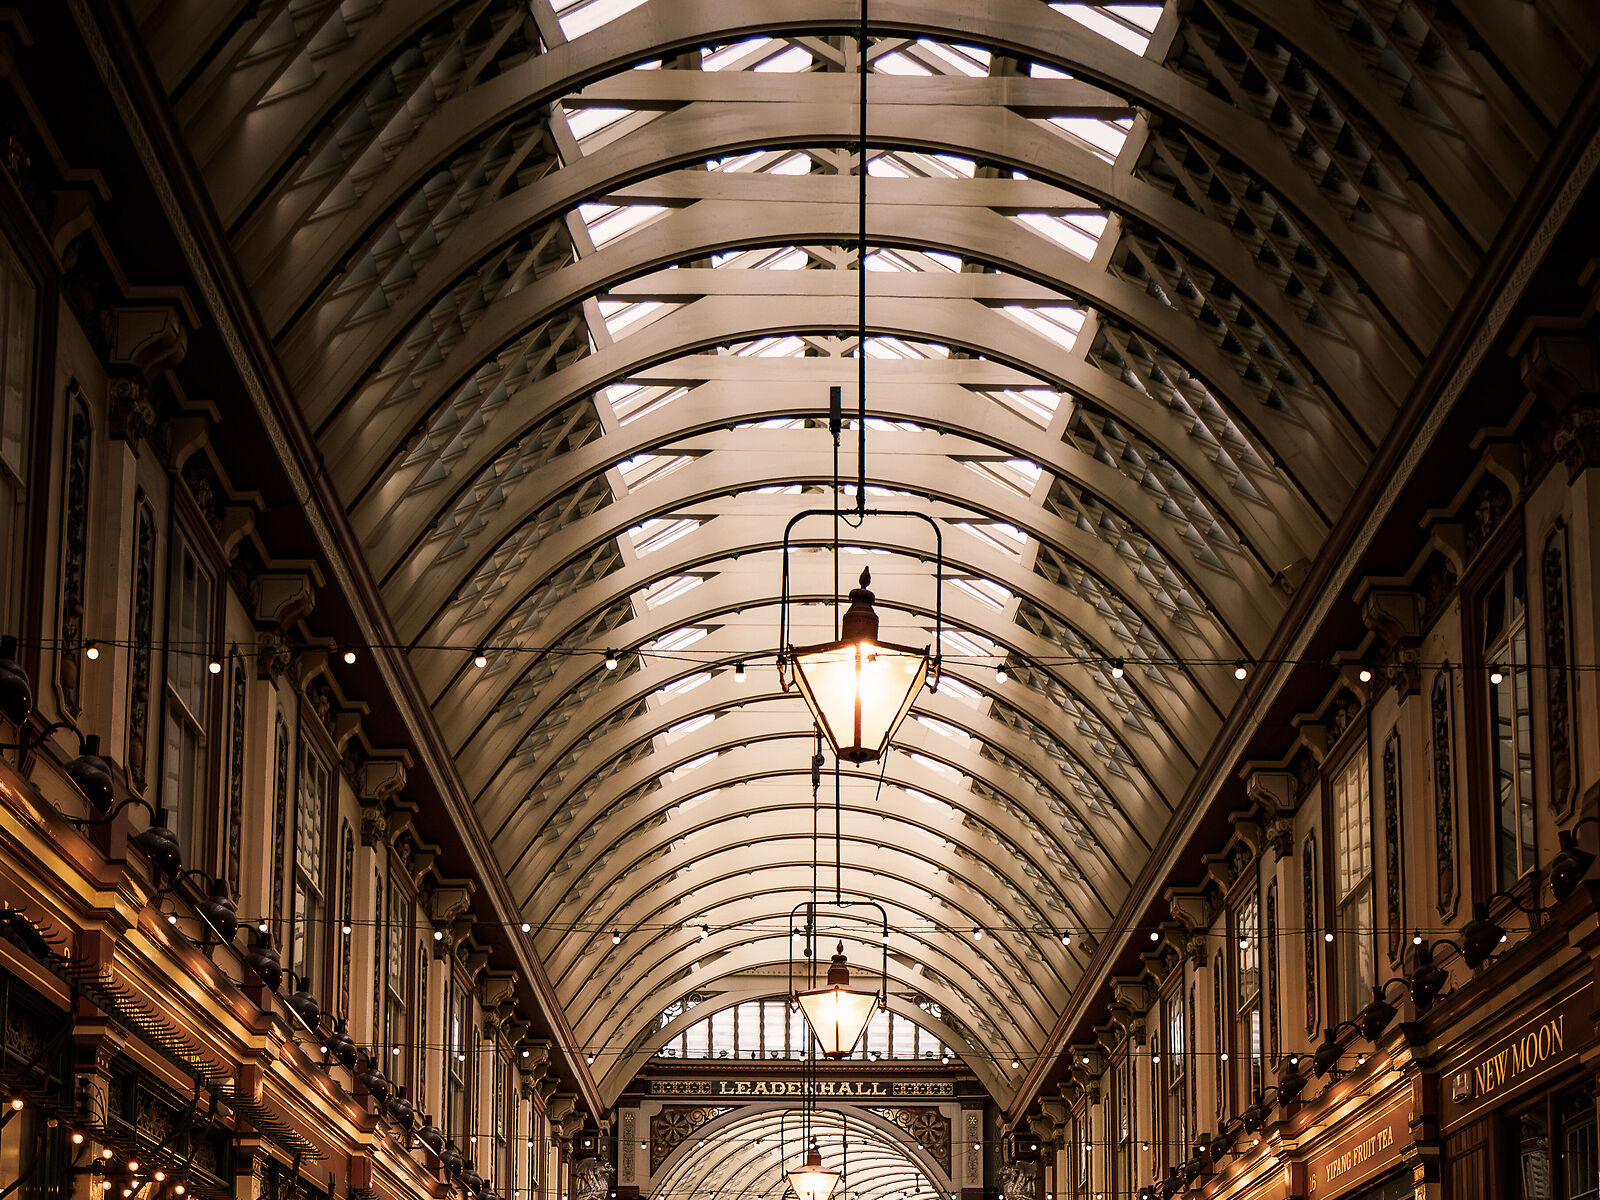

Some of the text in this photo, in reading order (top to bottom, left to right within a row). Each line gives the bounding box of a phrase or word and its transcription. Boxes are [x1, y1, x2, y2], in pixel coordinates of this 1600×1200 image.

[1475, 1014, 1564, 1099] NEW MOON
[719, 1081, 886, 1096] LEADENHALL
[1326, 1125, 1394, 1182] YIFANG FRUIT TEA
[1309, 1173, 1317, 1193] 16
